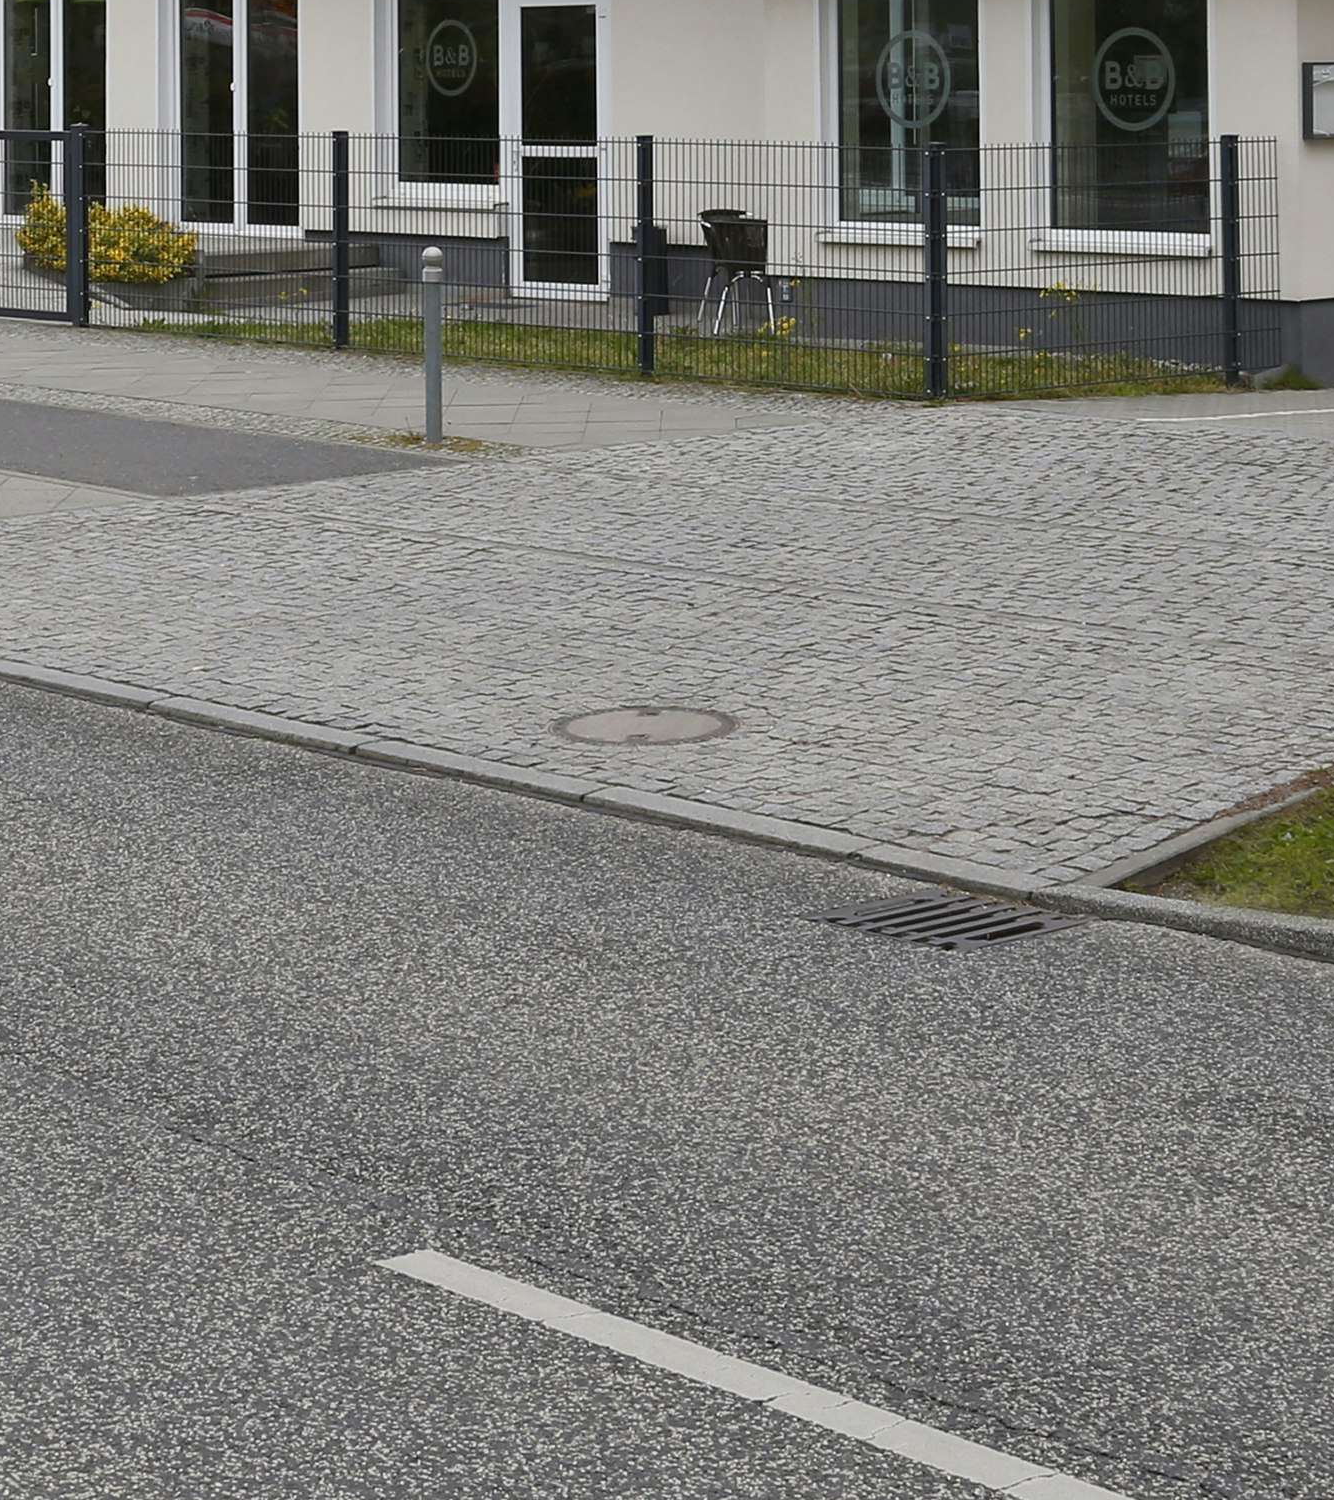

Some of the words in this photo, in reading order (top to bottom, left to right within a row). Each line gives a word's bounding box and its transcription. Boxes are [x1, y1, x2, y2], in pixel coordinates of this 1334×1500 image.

[433, 44, 469, 67] B&B
[888, 62, 940, 90] B&B
[1104, 61, 1164, 90] B&B
[1110, 94, 1157, 106] HOTELS
